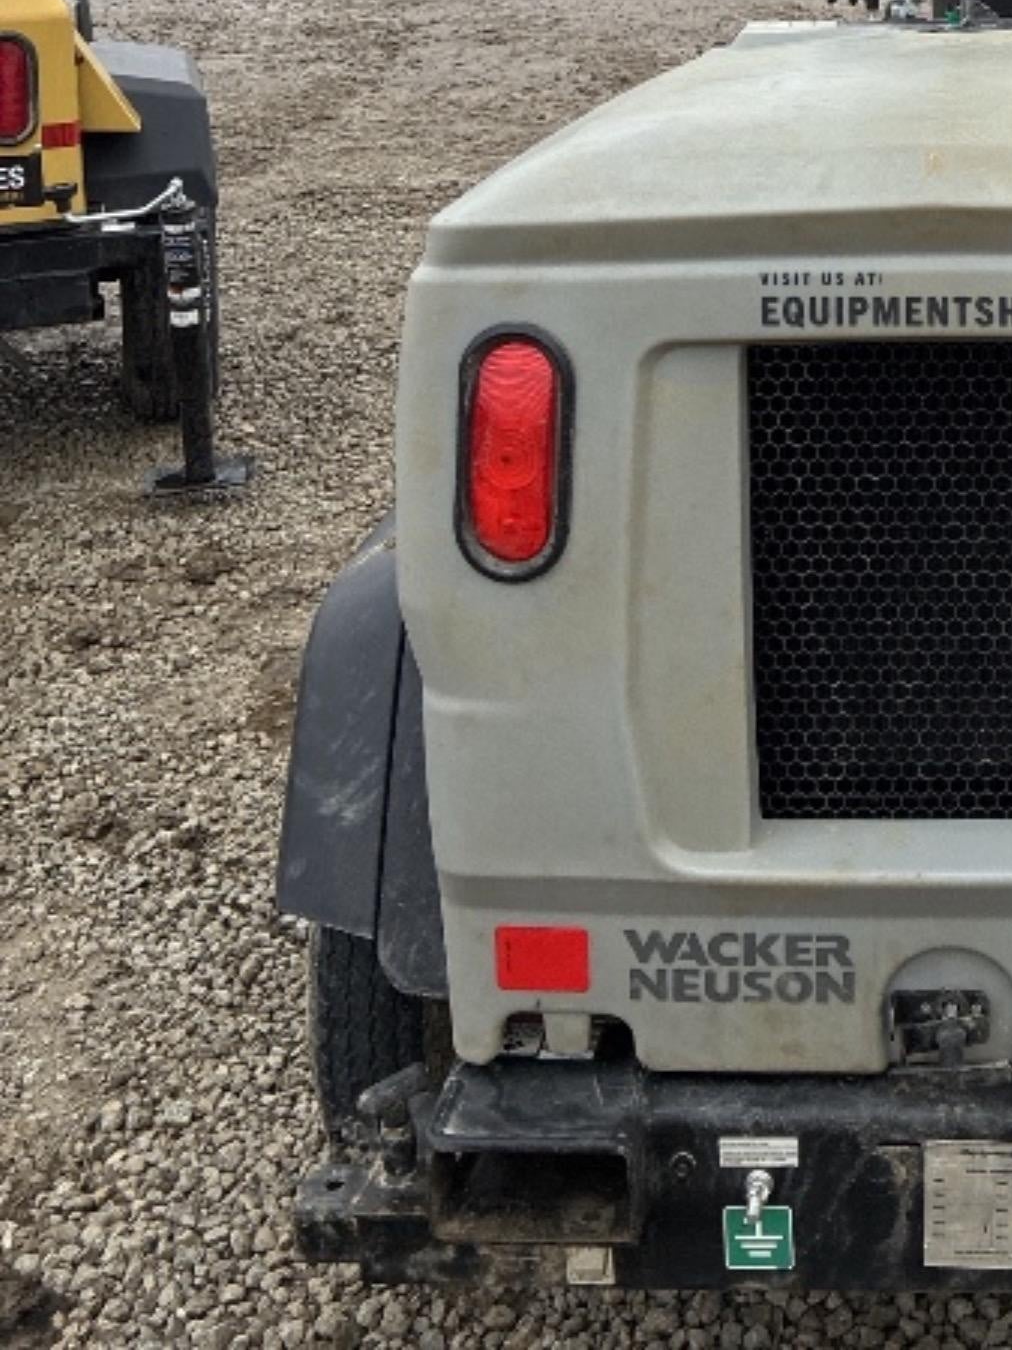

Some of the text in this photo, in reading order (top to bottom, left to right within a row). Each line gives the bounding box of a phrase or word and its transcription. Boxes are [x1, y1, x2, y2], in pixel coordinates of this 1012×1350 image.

[760, 272, 810, 286] VISIT
[821, 272, 844, 286] US
[623, 929, 853, 967] WACKER
[629, 967, 856, 1004] NEUSON
